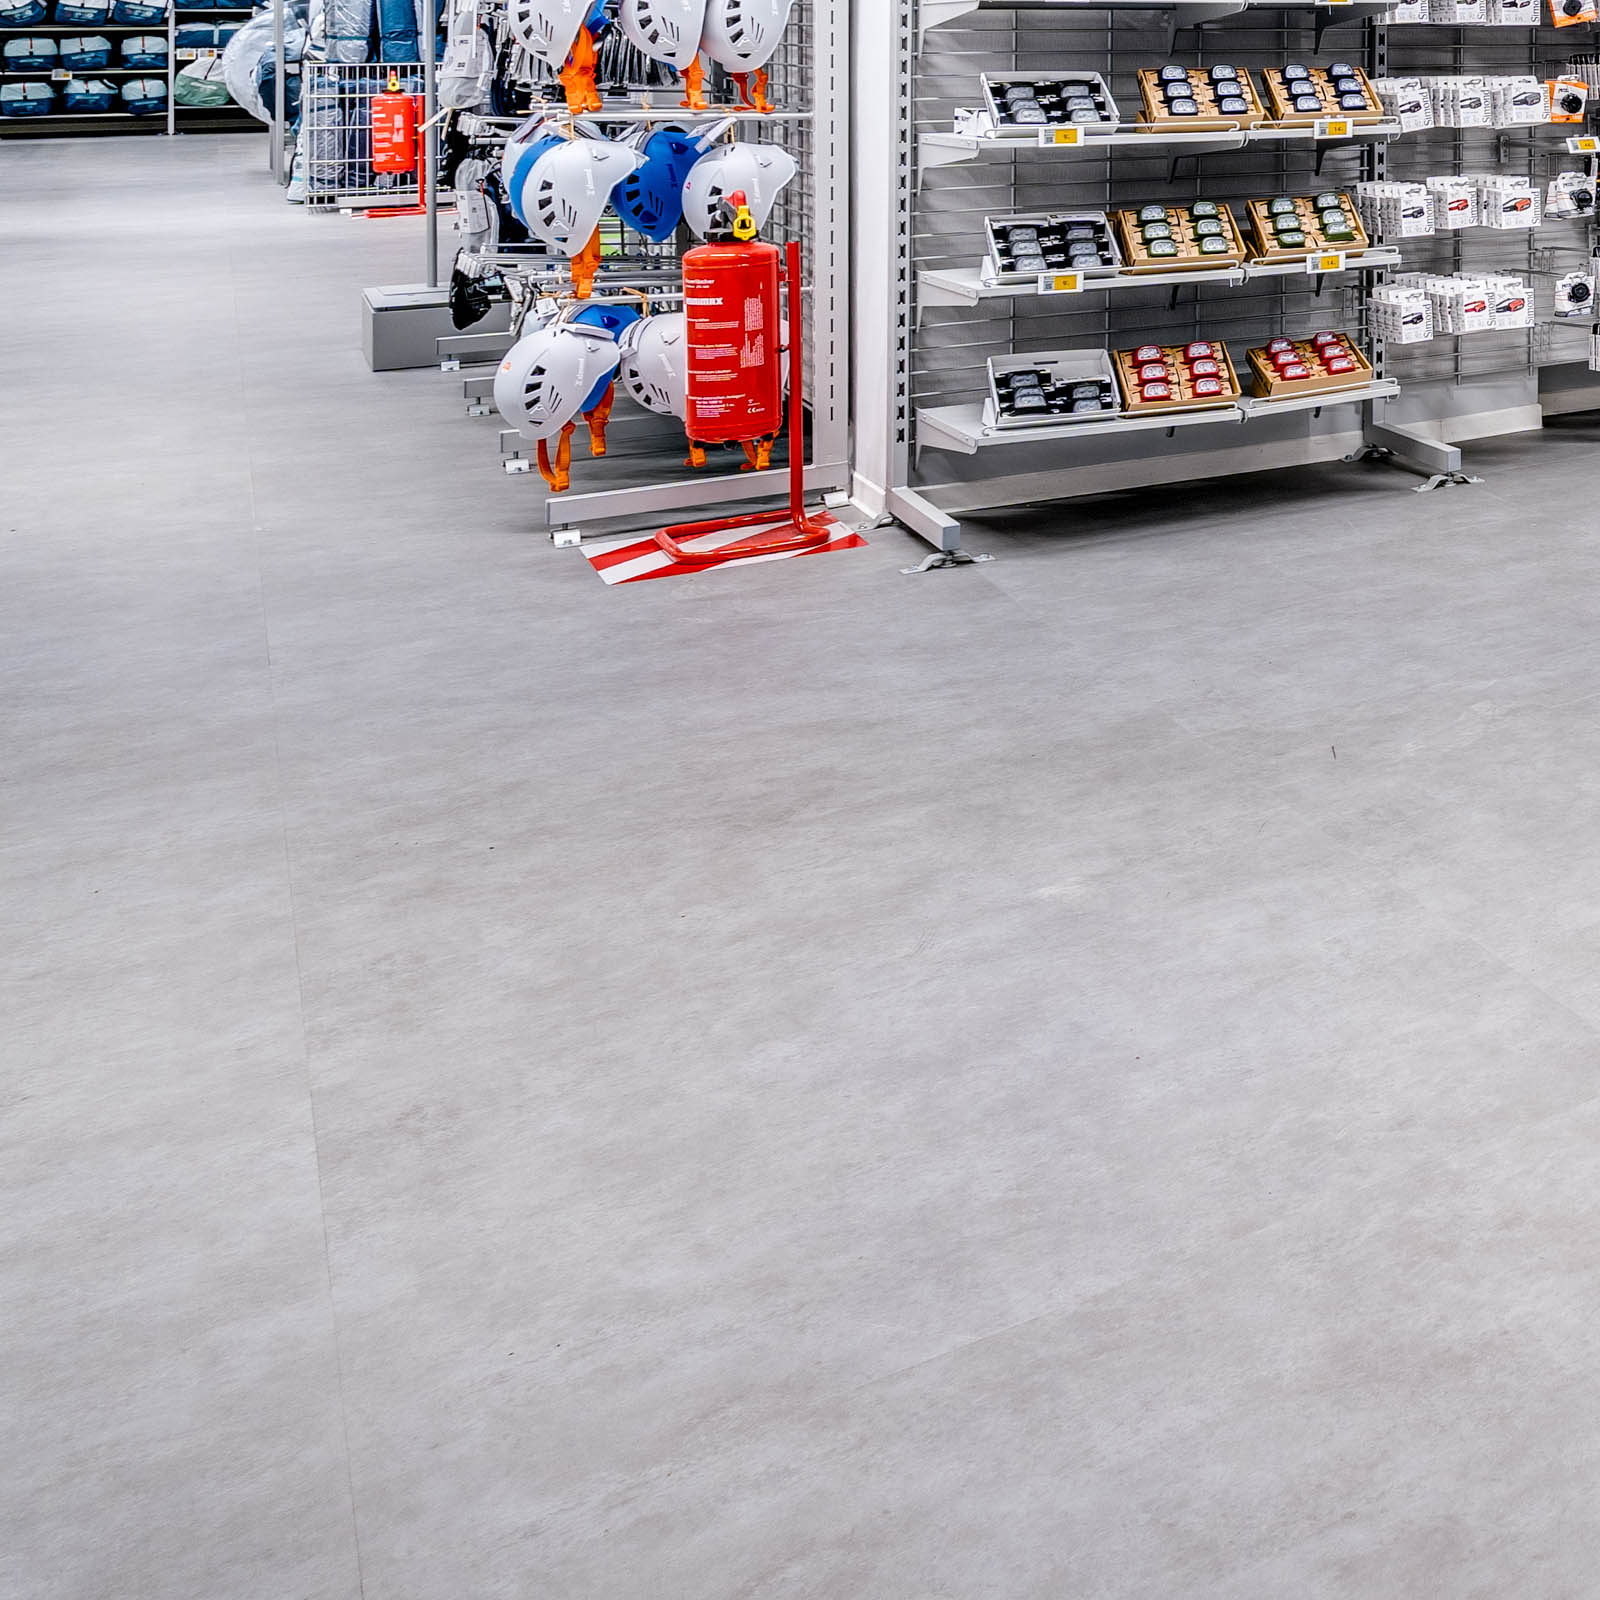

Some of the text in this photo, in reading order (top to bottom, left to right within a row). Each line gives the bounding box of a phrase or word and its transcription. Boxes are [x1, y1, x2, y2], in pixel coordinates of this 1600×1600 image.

[1423, 87, 1432, 126] Simond
[1482, 86, 1490, 123] Simond
[1542, 85, 1550, 121] Simond
[1425, 197, 1434, 233] Simond
[1469, 189, 1478, 224] Simond
[1532, 190, 1541, 225] Simond
[1423, 302, 1433, 339] Simond
[1487, 291, 1496, 327] Simond
[1525, 291, 1534, 325] Simond
